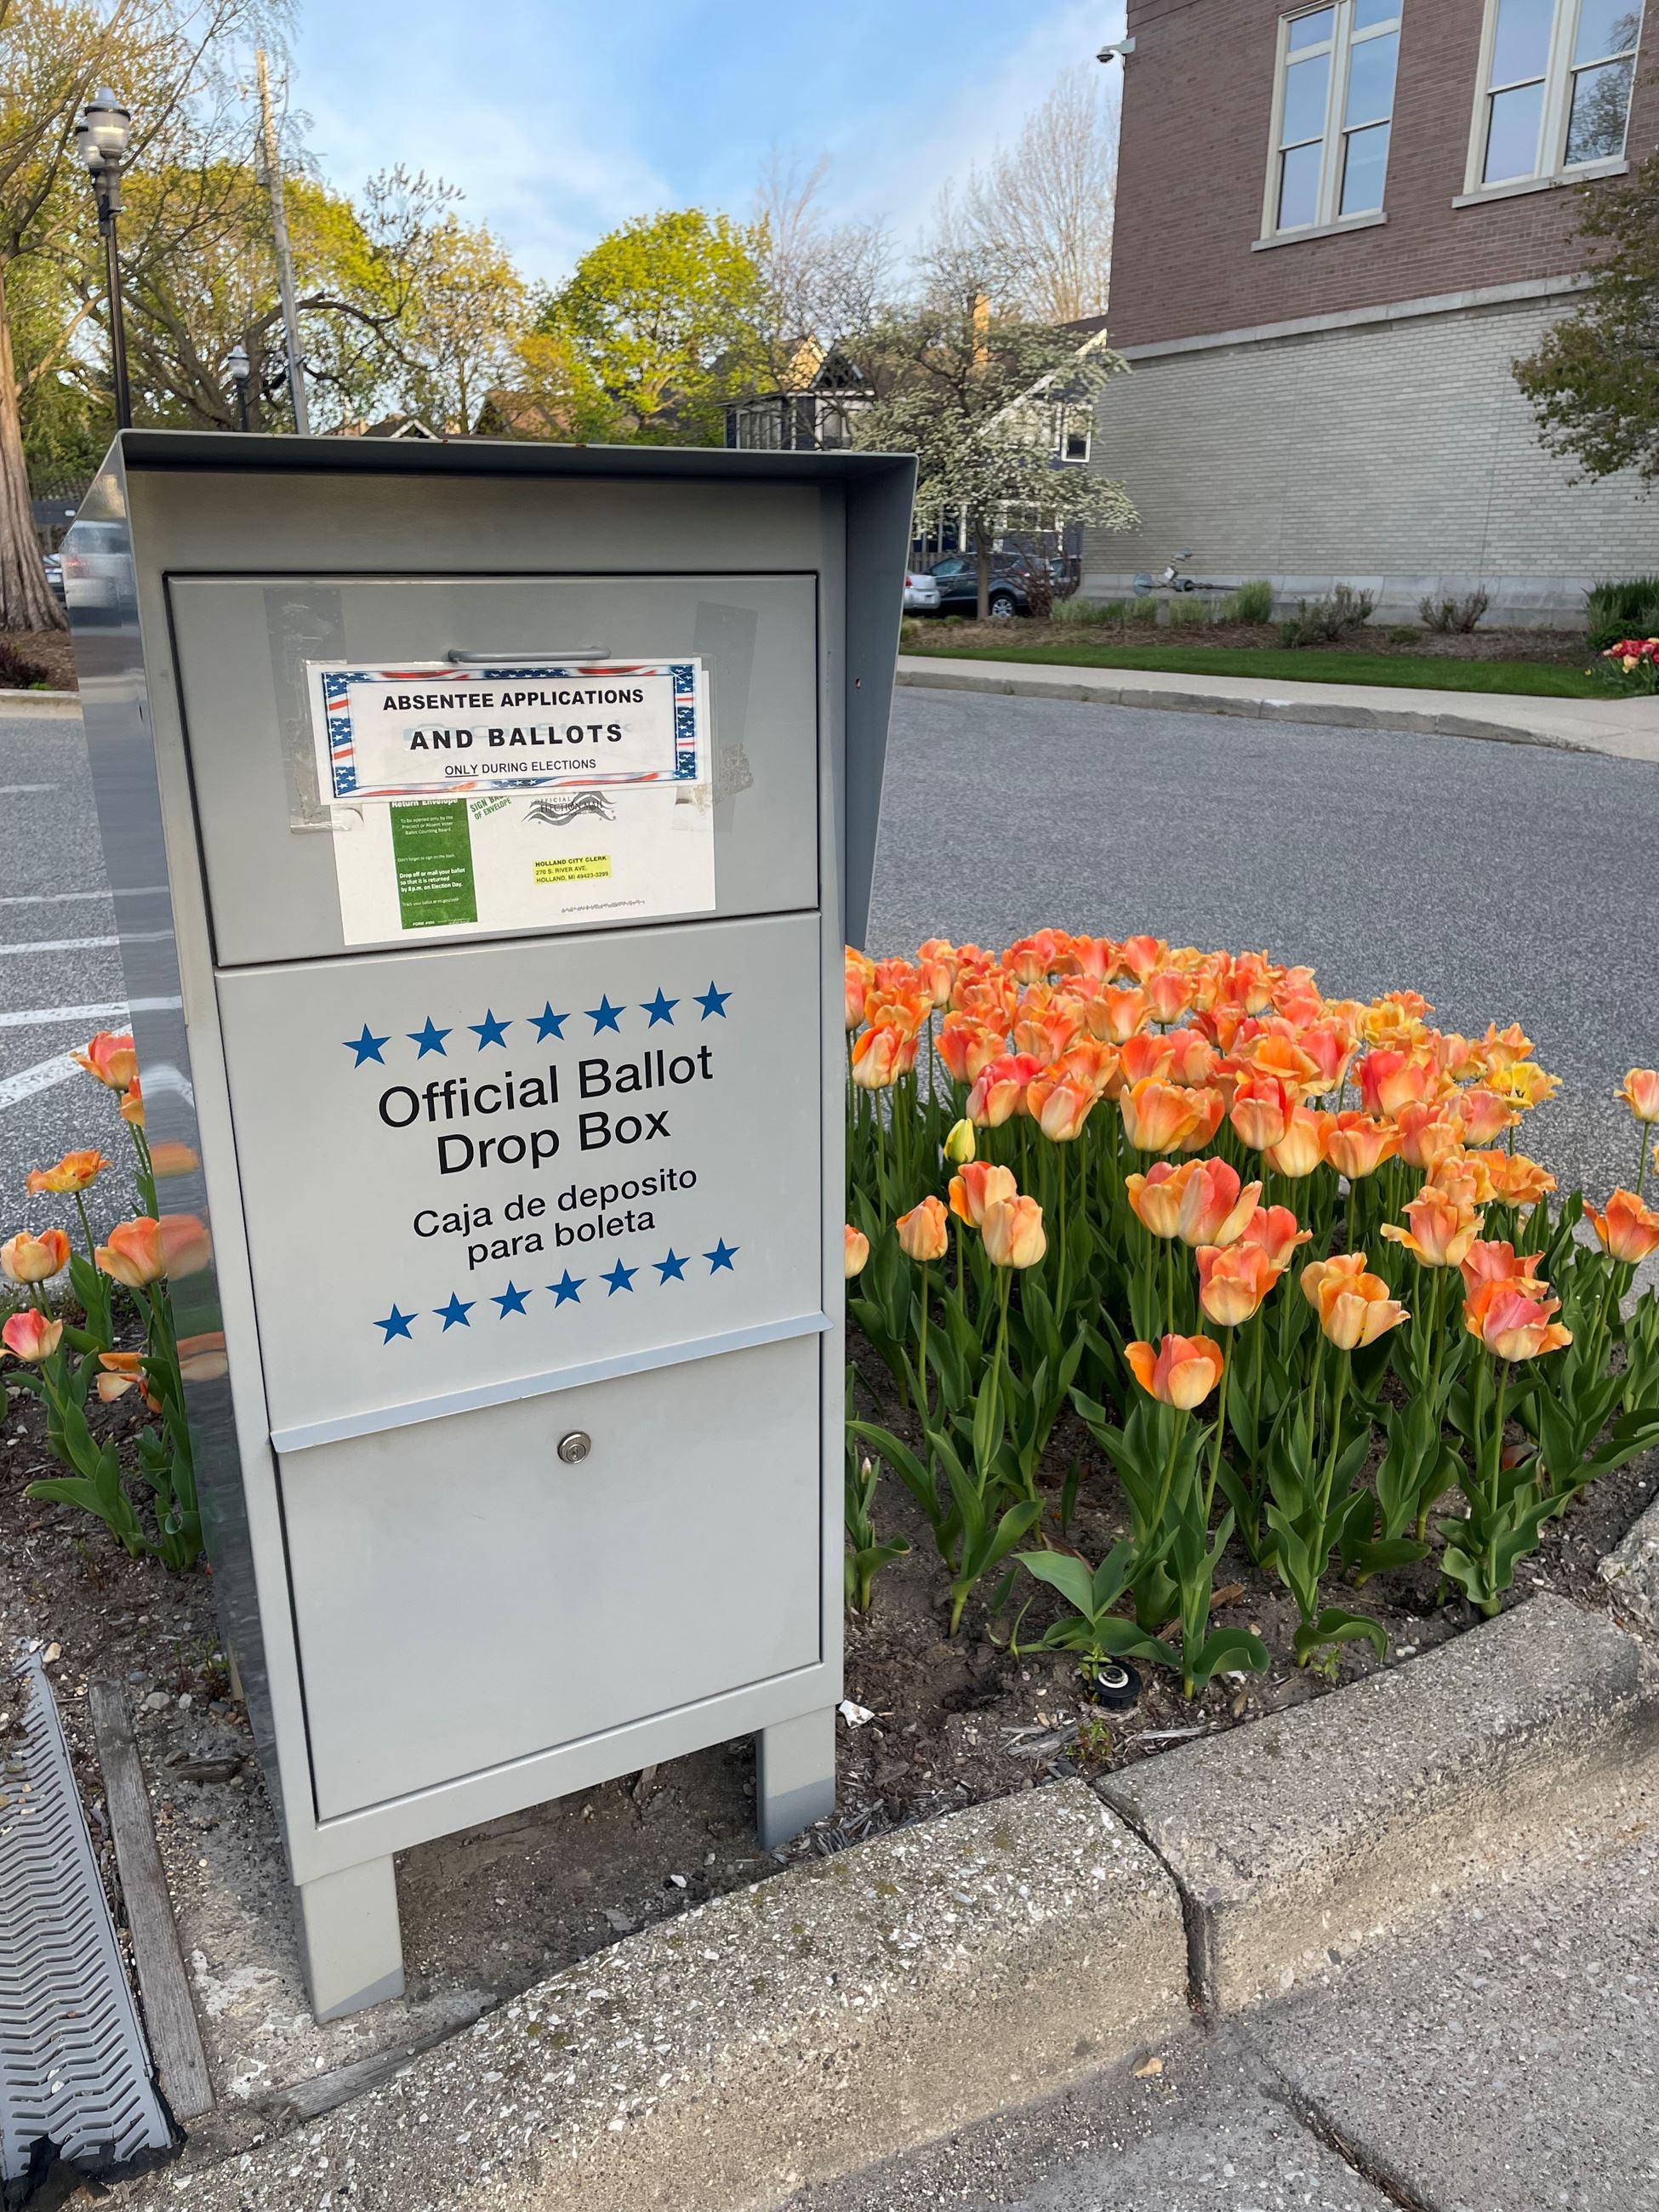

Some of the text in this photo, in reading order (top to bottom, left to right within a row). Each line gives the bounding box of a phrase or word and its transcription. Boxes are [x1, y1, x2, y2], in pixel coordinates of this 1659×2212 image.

[383, 689, 644, 711] ABSENTEE APPLICATIONS
[410, 723, 623, 750] AND BALLOTS
[444, 759, 596, 776] ONLY DURING ELECTIONS
[470, 798, 488, 812] SIGN
[474, 797, 512, 820] OF ENVELOPE
[536, 875, 567, 884] HOLLAND,
[577, 870, 609, 879] 49423-3299
[379, 1045, 714, 1128] Official Ballot
[437, 1109, 671, 1175] Drop Box
[413, 1167, 698, 1238] Caja de deposito
[467, 1209, 656, 1270] para boleta
